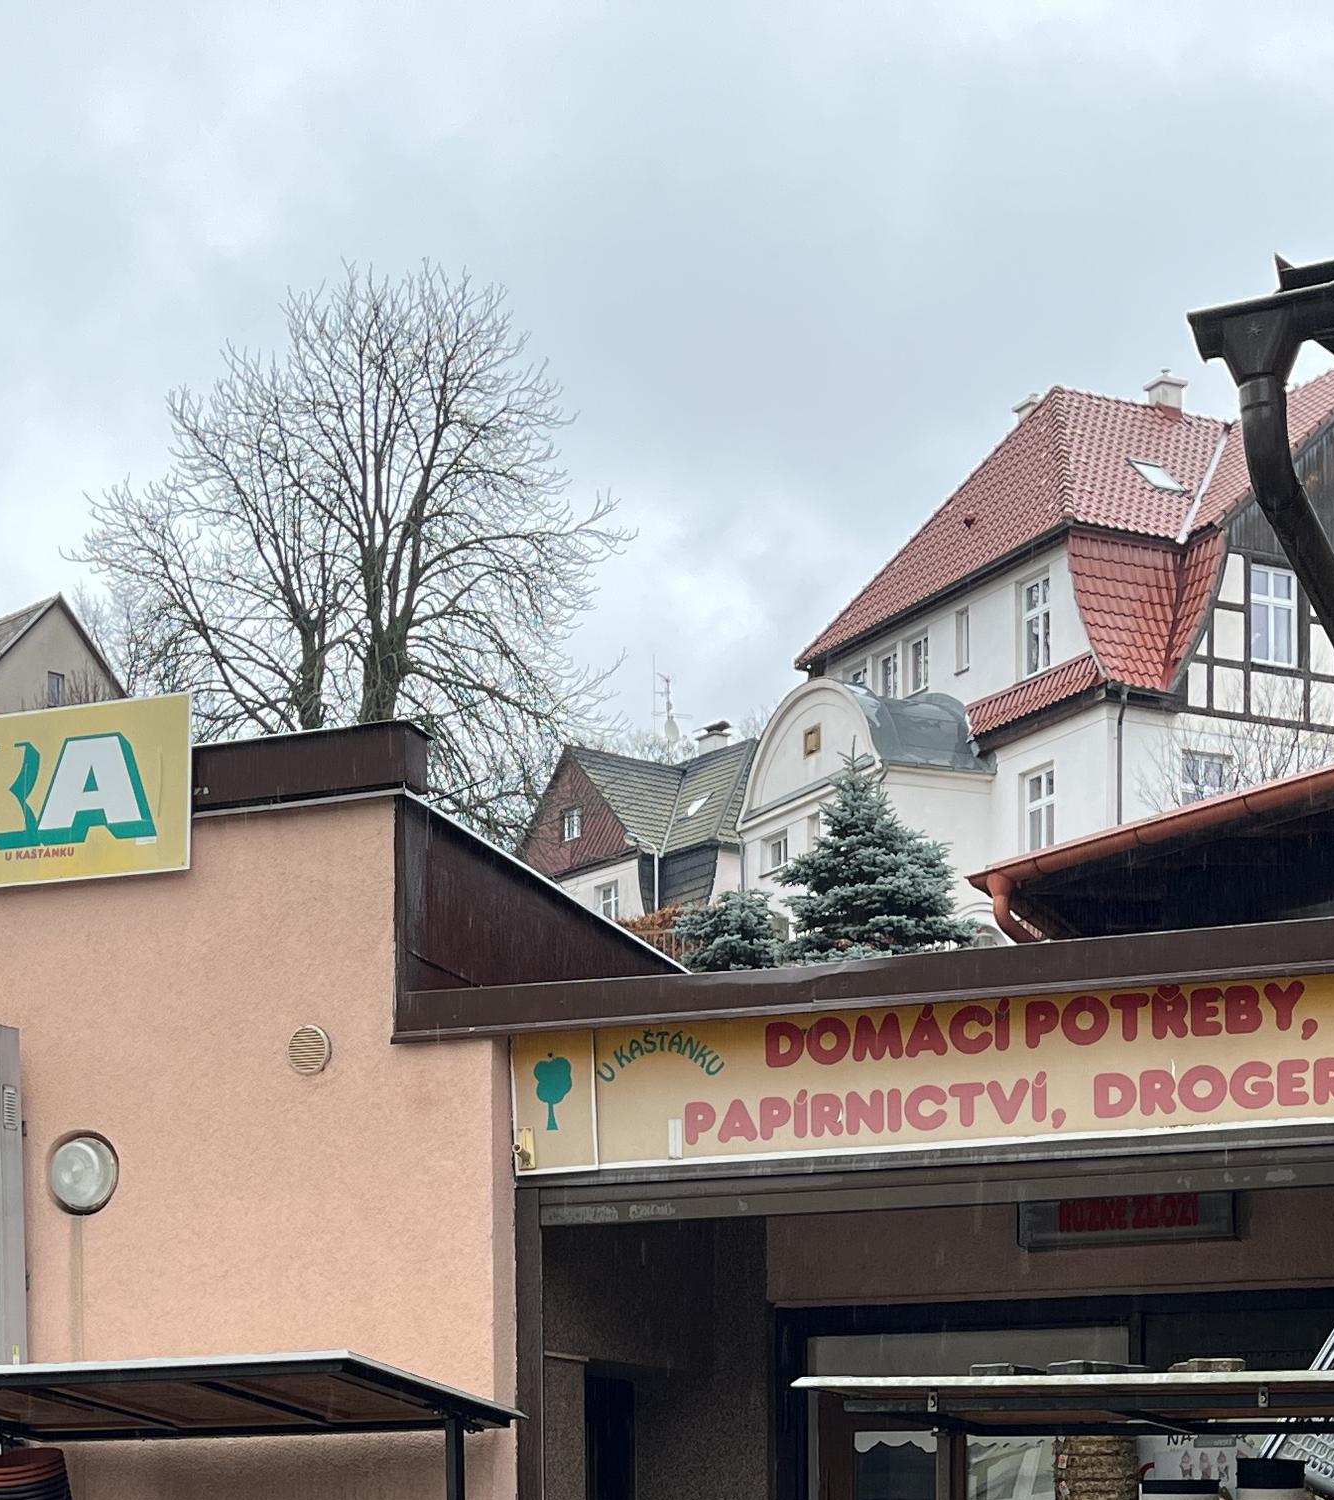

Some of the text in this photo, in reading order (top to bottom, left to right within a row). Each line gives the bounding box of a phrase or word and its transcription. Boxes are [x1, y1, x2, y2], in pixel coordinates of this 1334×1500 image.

[4, 851, 12, 861] U
[597, 1028, 726, 1083] U KAŠTÁNKU
[765, 980, 1319, 1068] DOMÁCÍ POTŘEBY,
[684, 1071, 1067, 1146] PAPÍRNICTVÍ,
